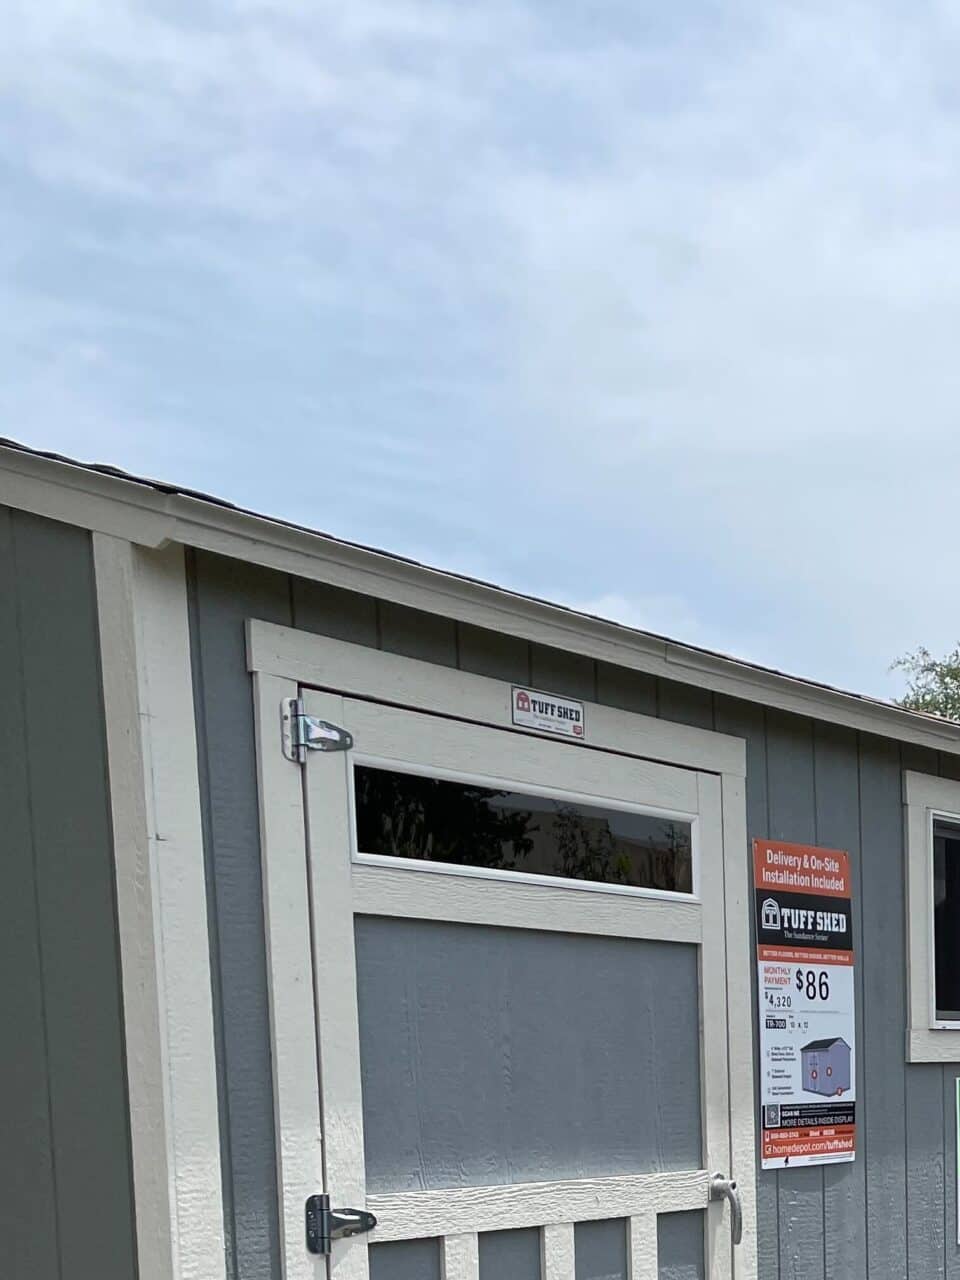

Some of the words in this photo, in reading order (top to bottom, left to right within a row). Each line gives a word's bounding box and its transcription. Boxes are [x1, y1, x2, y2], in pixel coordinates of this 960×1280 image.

[531, 699, 557, 717] TUFF
[557, 705, 581, 722] SHED
[766, 849, 802, 871] Delivery
[803, 854, 810, 868] &
[810, 855, 840, 872] On-Site
[762, 867, 810, 887] Installation
[811, 874, 844, 891] Included
[781, 907, 814, 930] TUFF
[816, 912, 847, 933] SHED
[764, 965, 792, 976] MONTHLY
[764, 976, 791, 986] PAYMENT
[795, 968, 830, 1001] $86
[765, 991, 792, 1009] $4,320
[798, 1118, 818, 1126] DETAILS
[834, 1116, 854, 1124] DISPLAY
[772, 1138, 853, 1154] homedepot.com/tuffshed
